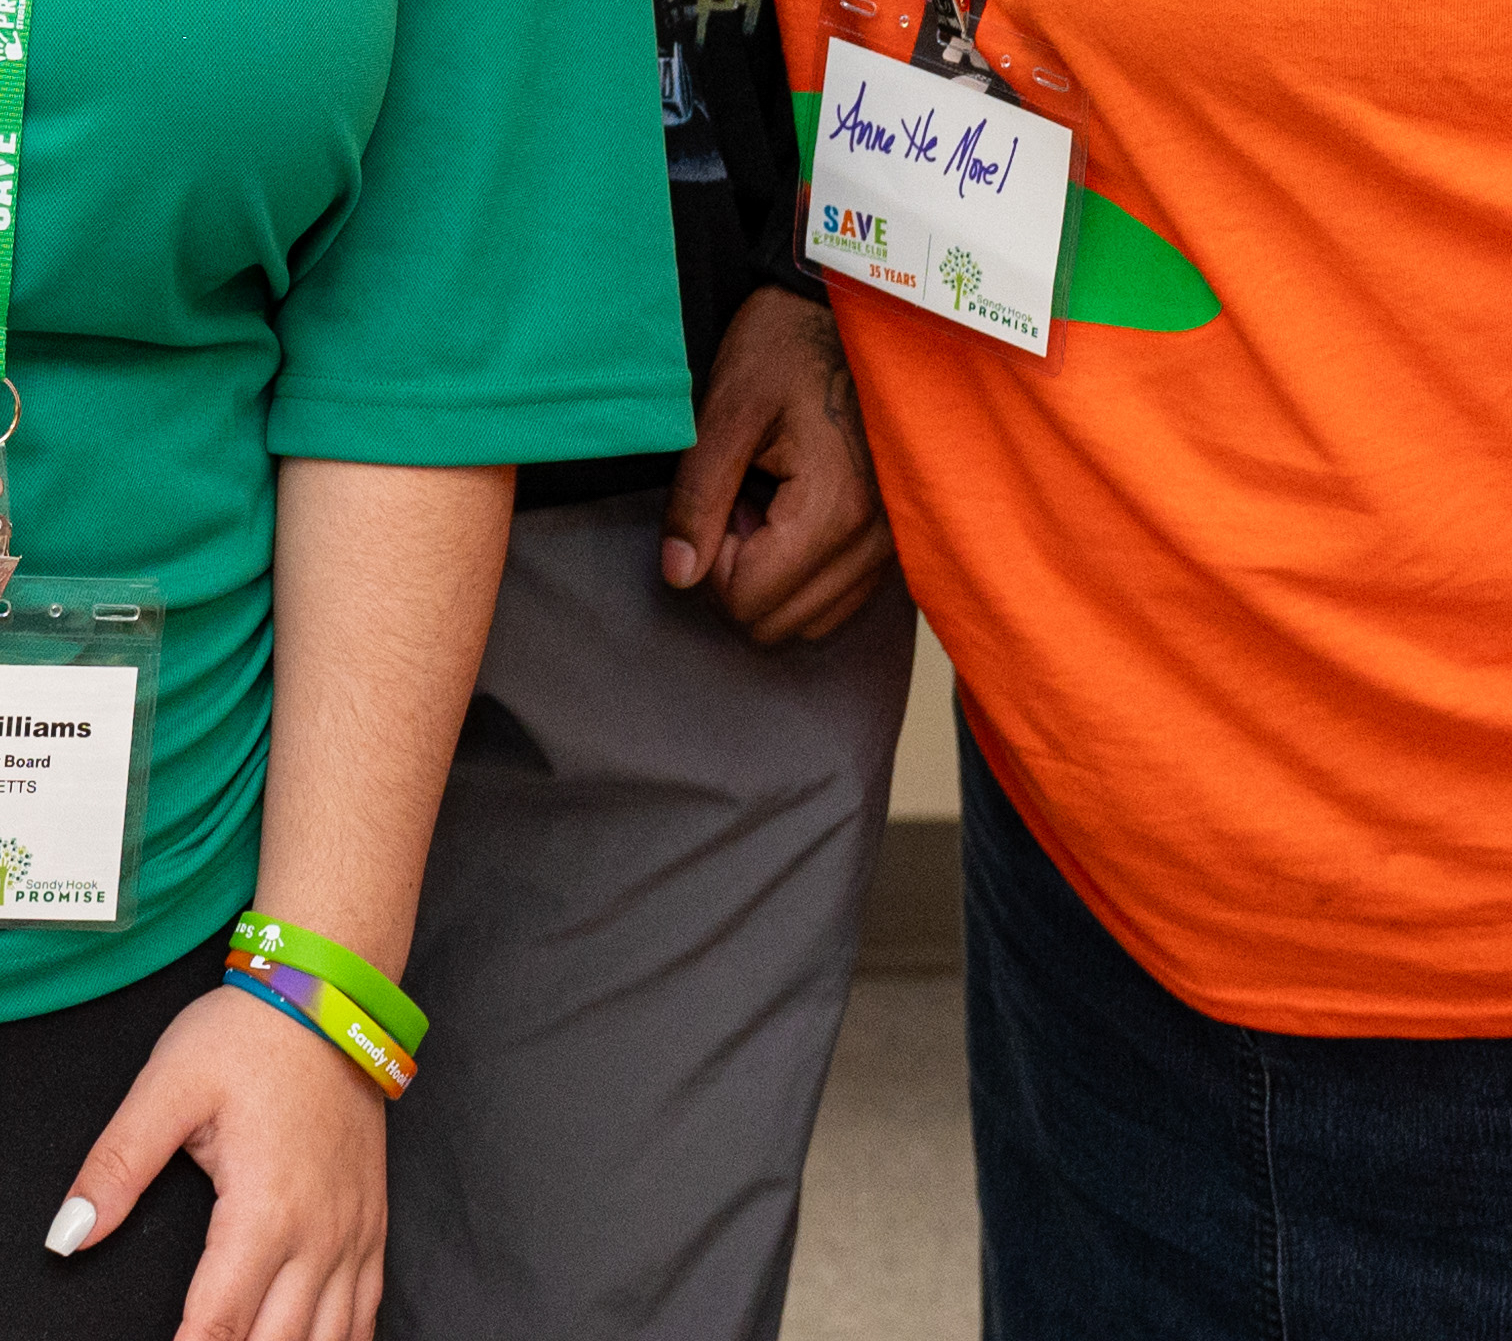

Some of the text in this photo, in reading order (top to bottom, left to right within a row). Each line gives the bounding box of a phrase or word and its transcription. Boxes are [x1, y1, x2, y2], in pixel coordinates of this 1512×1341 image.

[823, 204, 888, 247] SAVE
[823, 233, 862, 252] PROMISE
[869, 263, 917, 288] 35 YEARS
[968, 301, 1039, 338] PROMISE
[977, 294, 1033, 324] Sandy Hook
[4, 754, 52, 769] Board
[15, 890, 106, 904] PROMISE
[25, 878, 98, 891] Sandy Hook
[346, 1022, 388, 1067] Sandy
